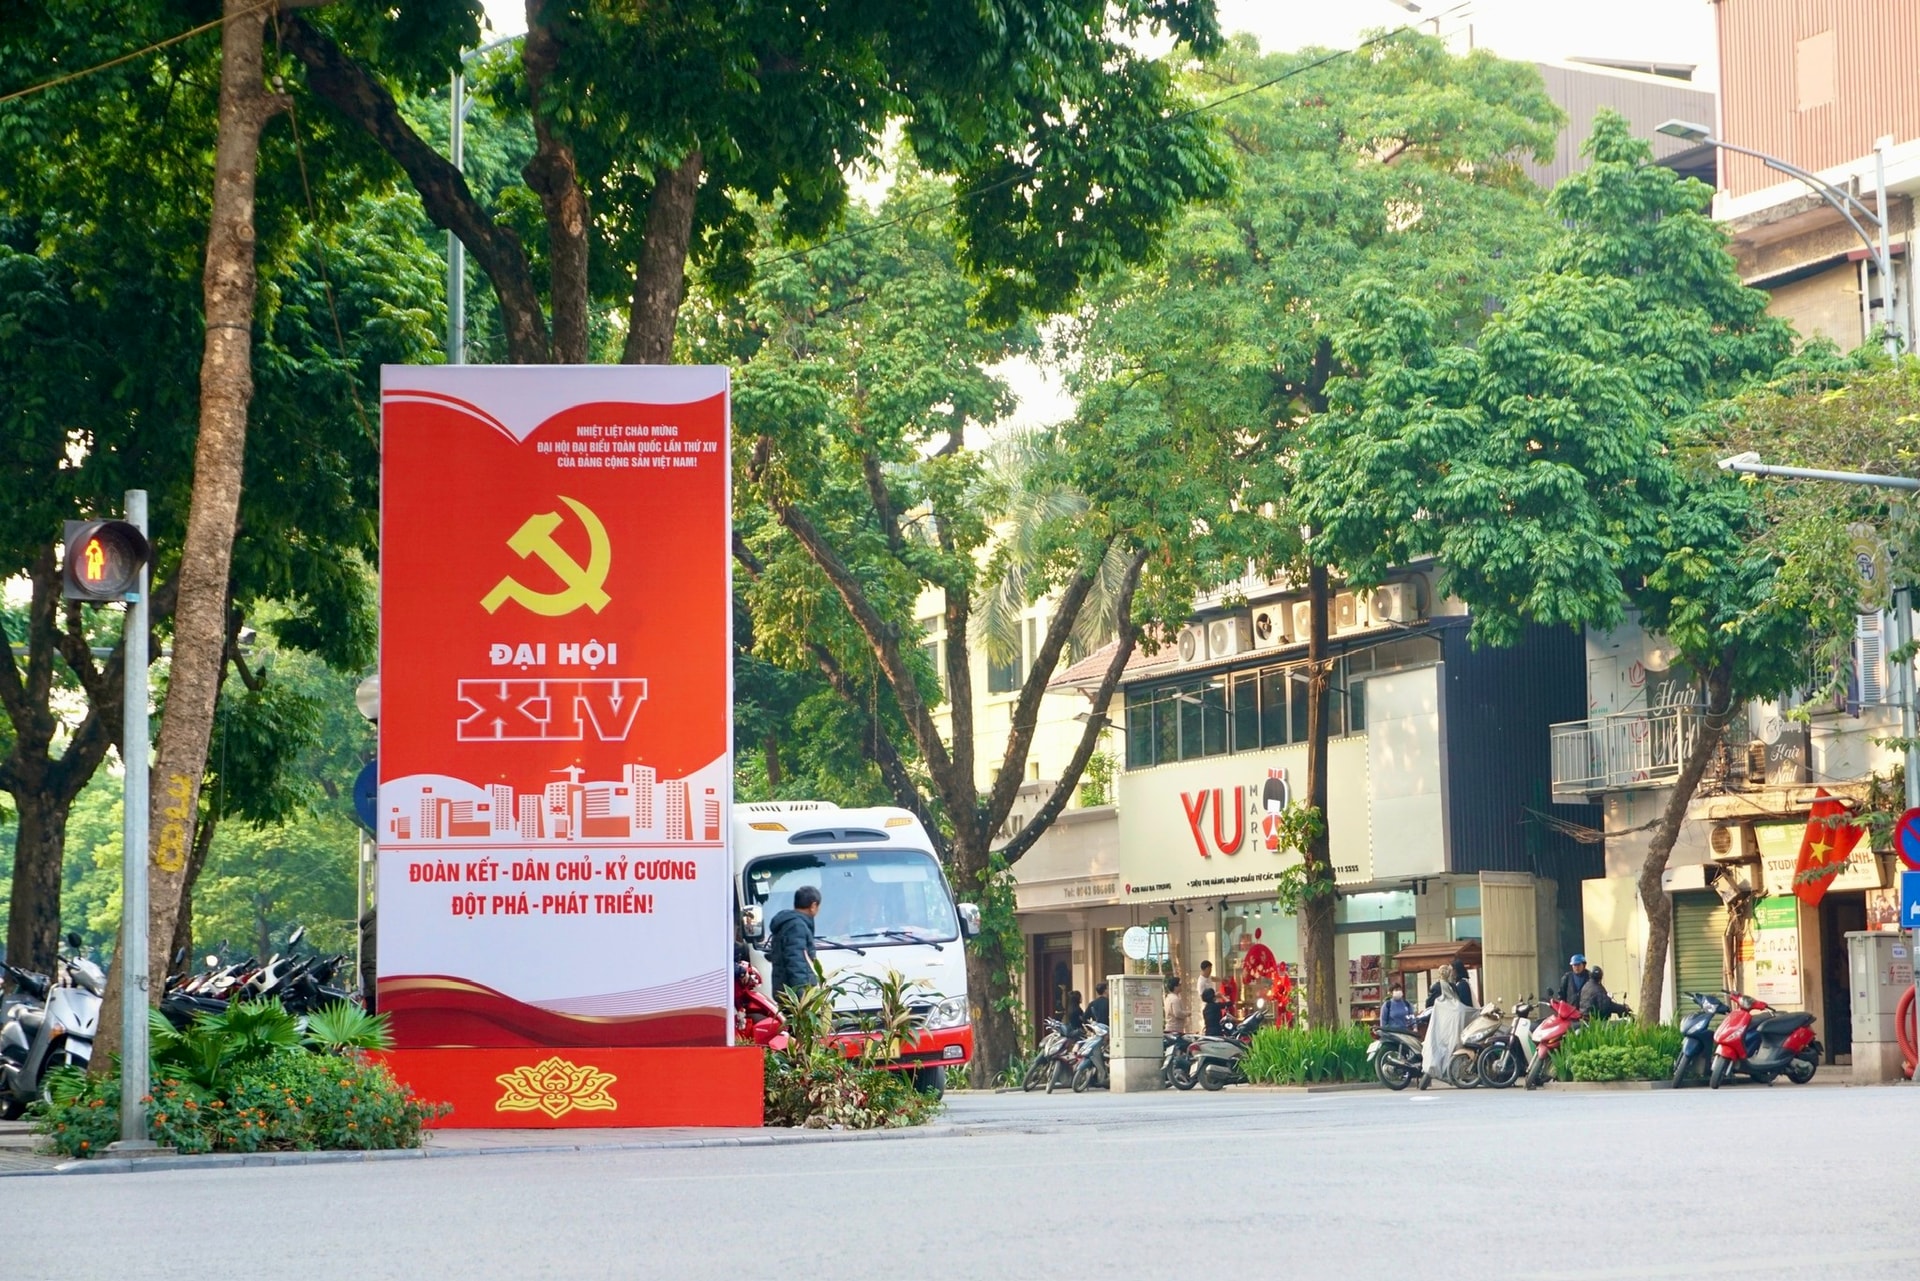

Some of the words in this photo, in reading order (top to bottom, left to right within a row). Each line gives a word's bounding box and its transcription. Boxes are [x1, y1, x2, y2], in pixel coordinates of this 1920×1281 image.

[577, 425, 602, 438] NHIỆT
[605, 425, 623, 438] LIỆT
[625, 424, 649, 436] CHÀO
[651, 424, 678, 436] MỪNG
[537, 442, 553, 455] ĐẠI
[554, 440, 570, 455] HỘI
[572, 442, 587, 455] ĐẠI
[589, 439, 610, 452] BIỂU
[612, 439, 636, 452] TOÀN
[637, 438, 662, 453] QUỐC
[664, 438, 681, 452] LẦN
[684, 440, 702, 452] THỨ
[703, 442, 717, 452] XIV
[557, 453, 576, 467] CỦA
[578, 453, 602, 467] ĐẢNG
[604, 455, 629, 469] CỘNG
[631, 453, 649, 467] SẢN
[652, 455, 670, 469] VIỆT
[673, 457, 698, 467] NAM!
[489, 643, 546, 671] ĐẠI
[558, 638, 617, 671] HỘI
[457, 678, 648, 742] XIV
[1653, 680, 1698, 716] Hair
[1770, 744, 1800, 761] Hair
[1768, 765, 1798, 785] Nail
[1180, 785, 1245, 858] YU
[1250, 784, 1258, 852] MART
[409, 859, 460, 882] ĐOÀN
[466, 856, 499, 882] KẾT
[512, 857, 550, 881] DÂN
[556, 855, 592, 881] CHỦ
[605, 854, 629, 881] KỶ
[634, 859, 696, 881] CƯƠNG
[452, 892, 487, 920] ĐỘT
[493, 891, 529, 915] PHÁ
[542, 890, 589, 914] PHÁT
[595, 886, 653, 914] TRIỂN!
